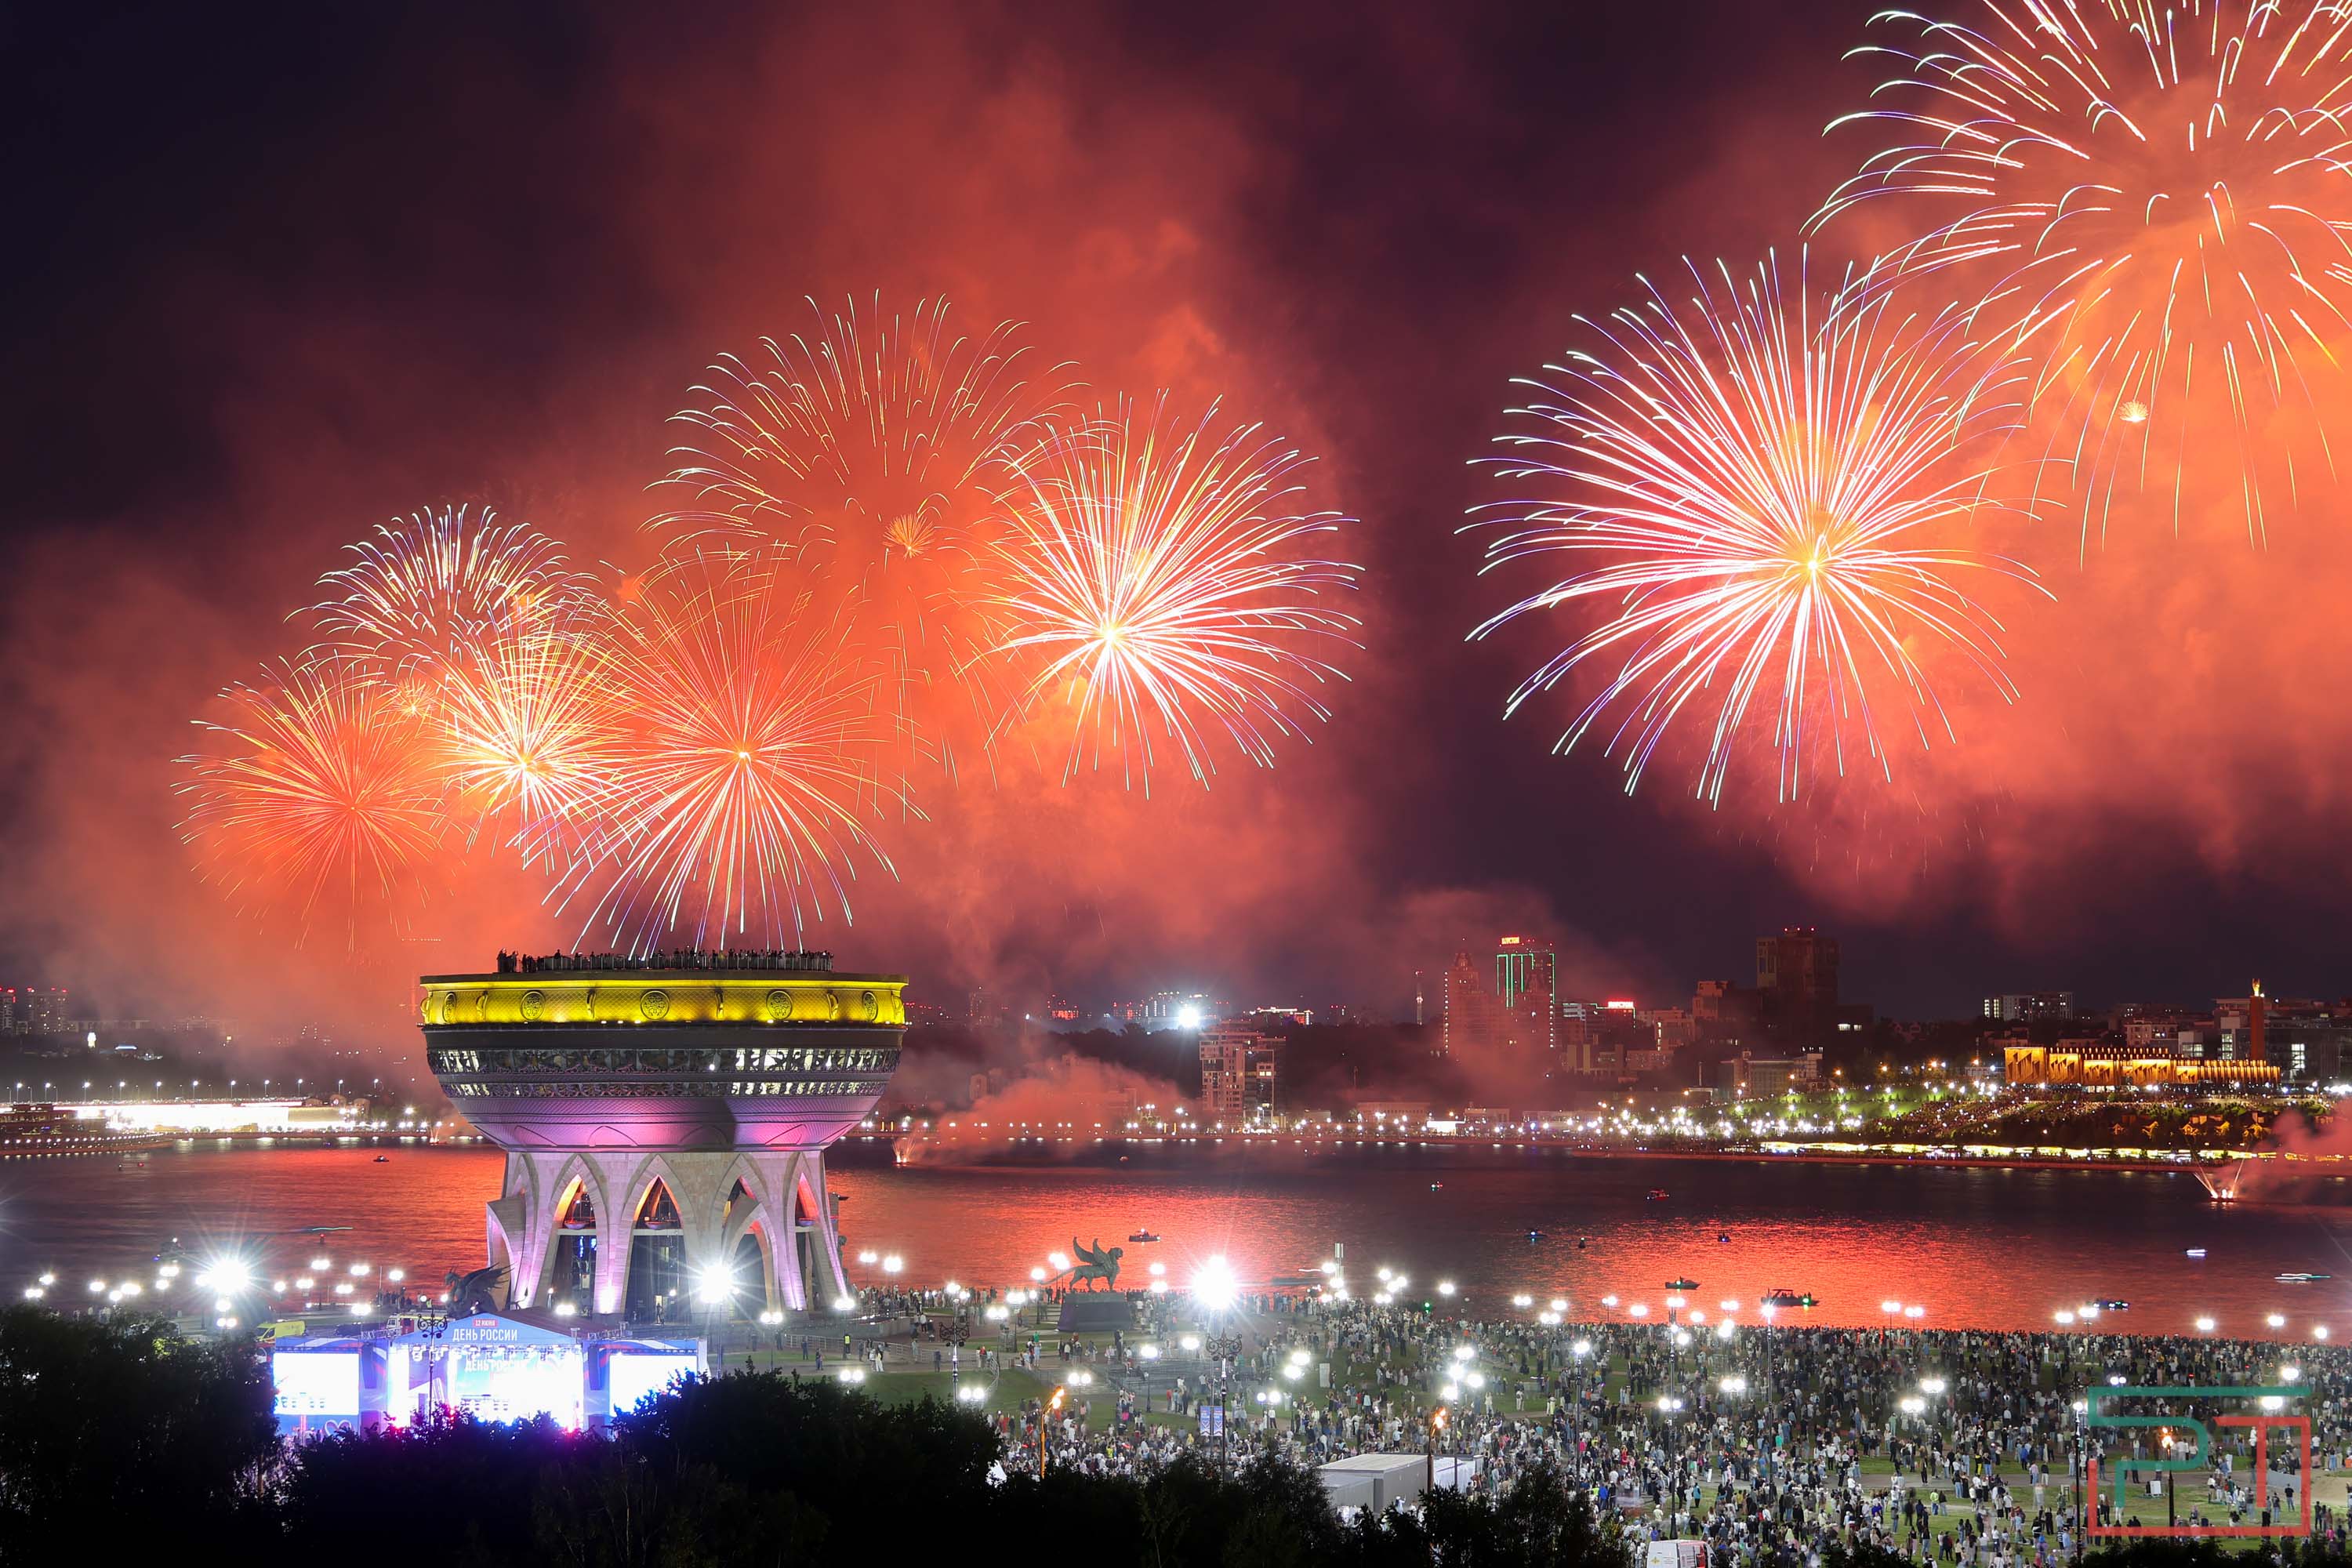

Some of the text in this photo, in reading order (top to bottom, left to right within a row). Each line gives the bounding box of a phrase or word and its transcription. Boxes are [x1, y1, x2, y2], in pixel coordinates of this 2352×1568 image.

[452, 1328, 517, 1342] ДЕНЬ РОССИИ
[465, 1359, 489, 1373] ДЕНЬ
